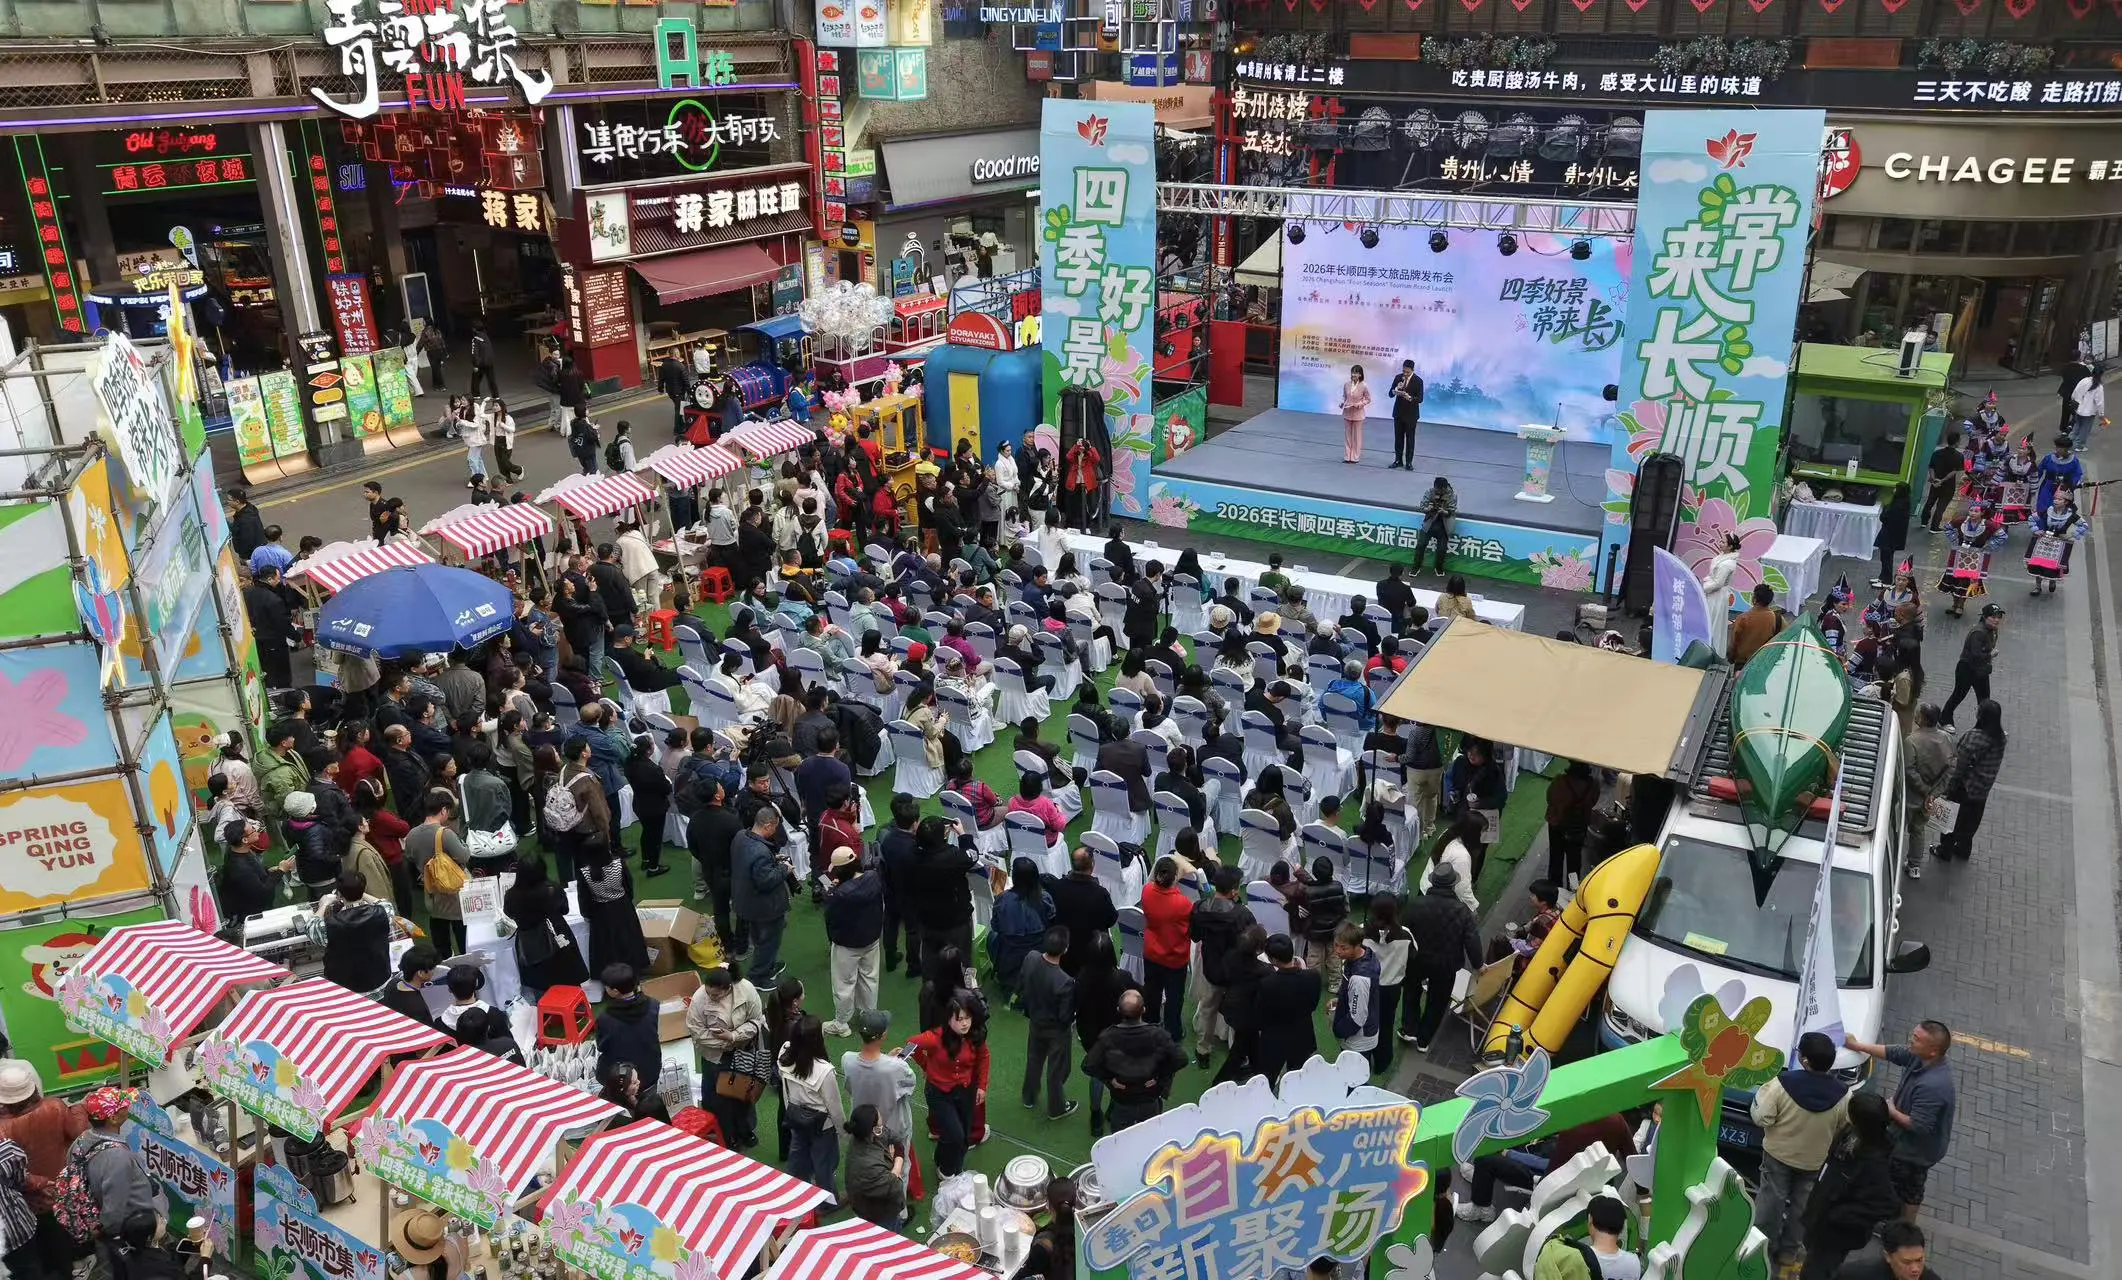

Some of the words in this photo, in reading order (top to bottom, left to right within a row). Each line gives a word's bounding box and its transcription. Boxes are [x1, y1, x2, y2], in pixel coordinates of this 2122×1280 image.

[406, 73, 466, 111] FUN
[1232, 87, 1309, 125] 贵州烧烤
[1914, 81, 2030, 103] 三天不吃酸
[2040, 81, 2122, 104] 走路打捞
[973, 156, 1015, 180] Good
[1017, 154, 1040, 174] me
[1884, 152, 2075, 184] CHAGEE
[481, 190, 541, 230] 蒋家
[674, 181, 800, 233] 蒋家肠旺面
[1057, 168, 1152, 387] 四季好景
[1303, 263, 1454, 284] 2026年长顺四季文旅品牌发布会
[1500, 276, 1588, 305] 四季好景
[951, 328, 995, 340] DORAYAKI
[1638, 187, 1797, 494] 常来长顺
[26, 837, 91, 857] QING
[39, 851, 96, 872] YUN
[141, 1138, 208, 1197] 长顺市集
[279, 1213, 354, 1279] 长顺市集
